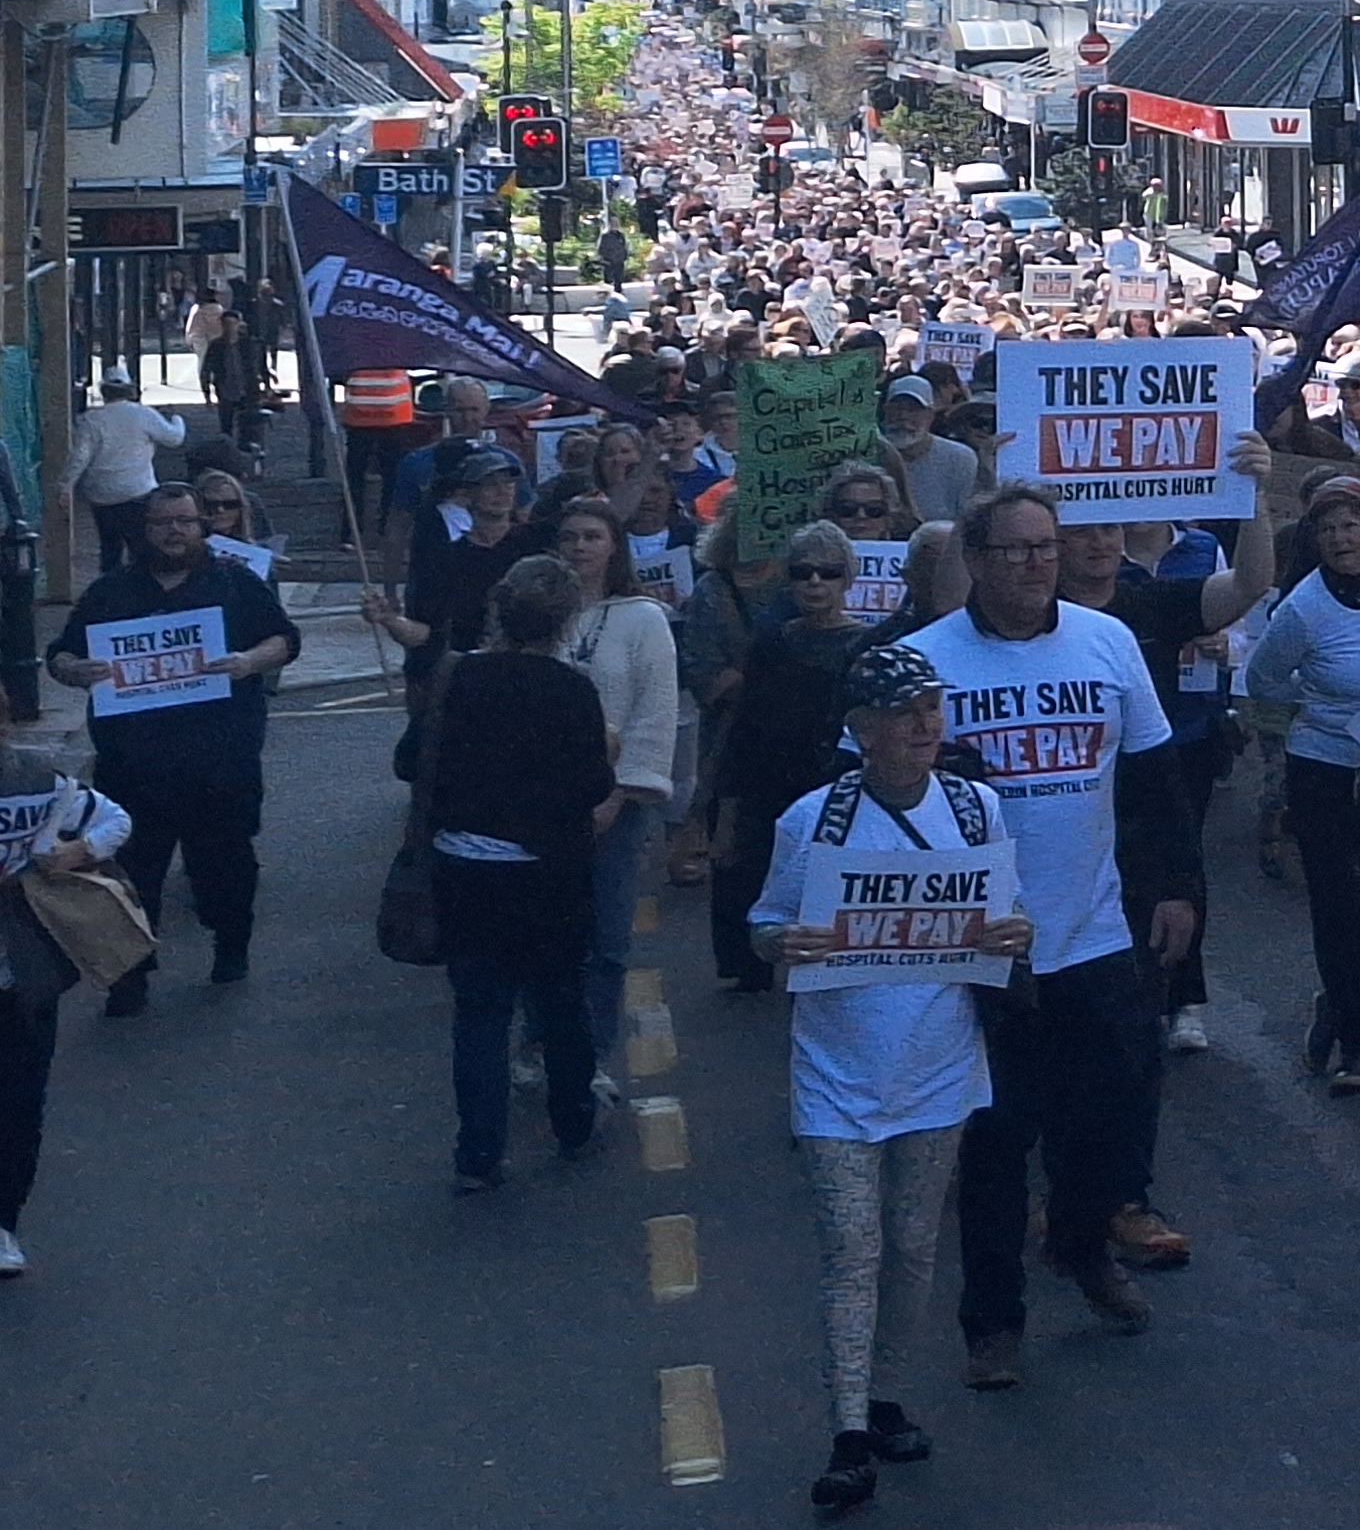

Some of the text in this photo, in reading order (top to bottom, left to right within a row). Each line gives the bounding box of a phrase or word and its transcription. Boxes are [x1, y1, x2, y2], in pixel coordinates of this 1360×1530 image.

[378, 168, 496, 193] Bath St
[1038, 364, 1218, 406] THEY SAVE
[1055, 417, 1202, 468] WE PAY
[1124, 479, 1168, 499] CUTS
[1172, 476, 1217, 496] HURT
[111, 624, 203, 656] THEY SAVE
[948, 681, 1105, 727] THEY SAVE
[1034, 725, 1095, 768] PAY
[841, 870, 990, 904] THEY SAVE
[848, 911, 974, 947] WE PAY
[826, 952, 892, 968] HOSPITAL
[899, 952, 934, 966] CUTS
